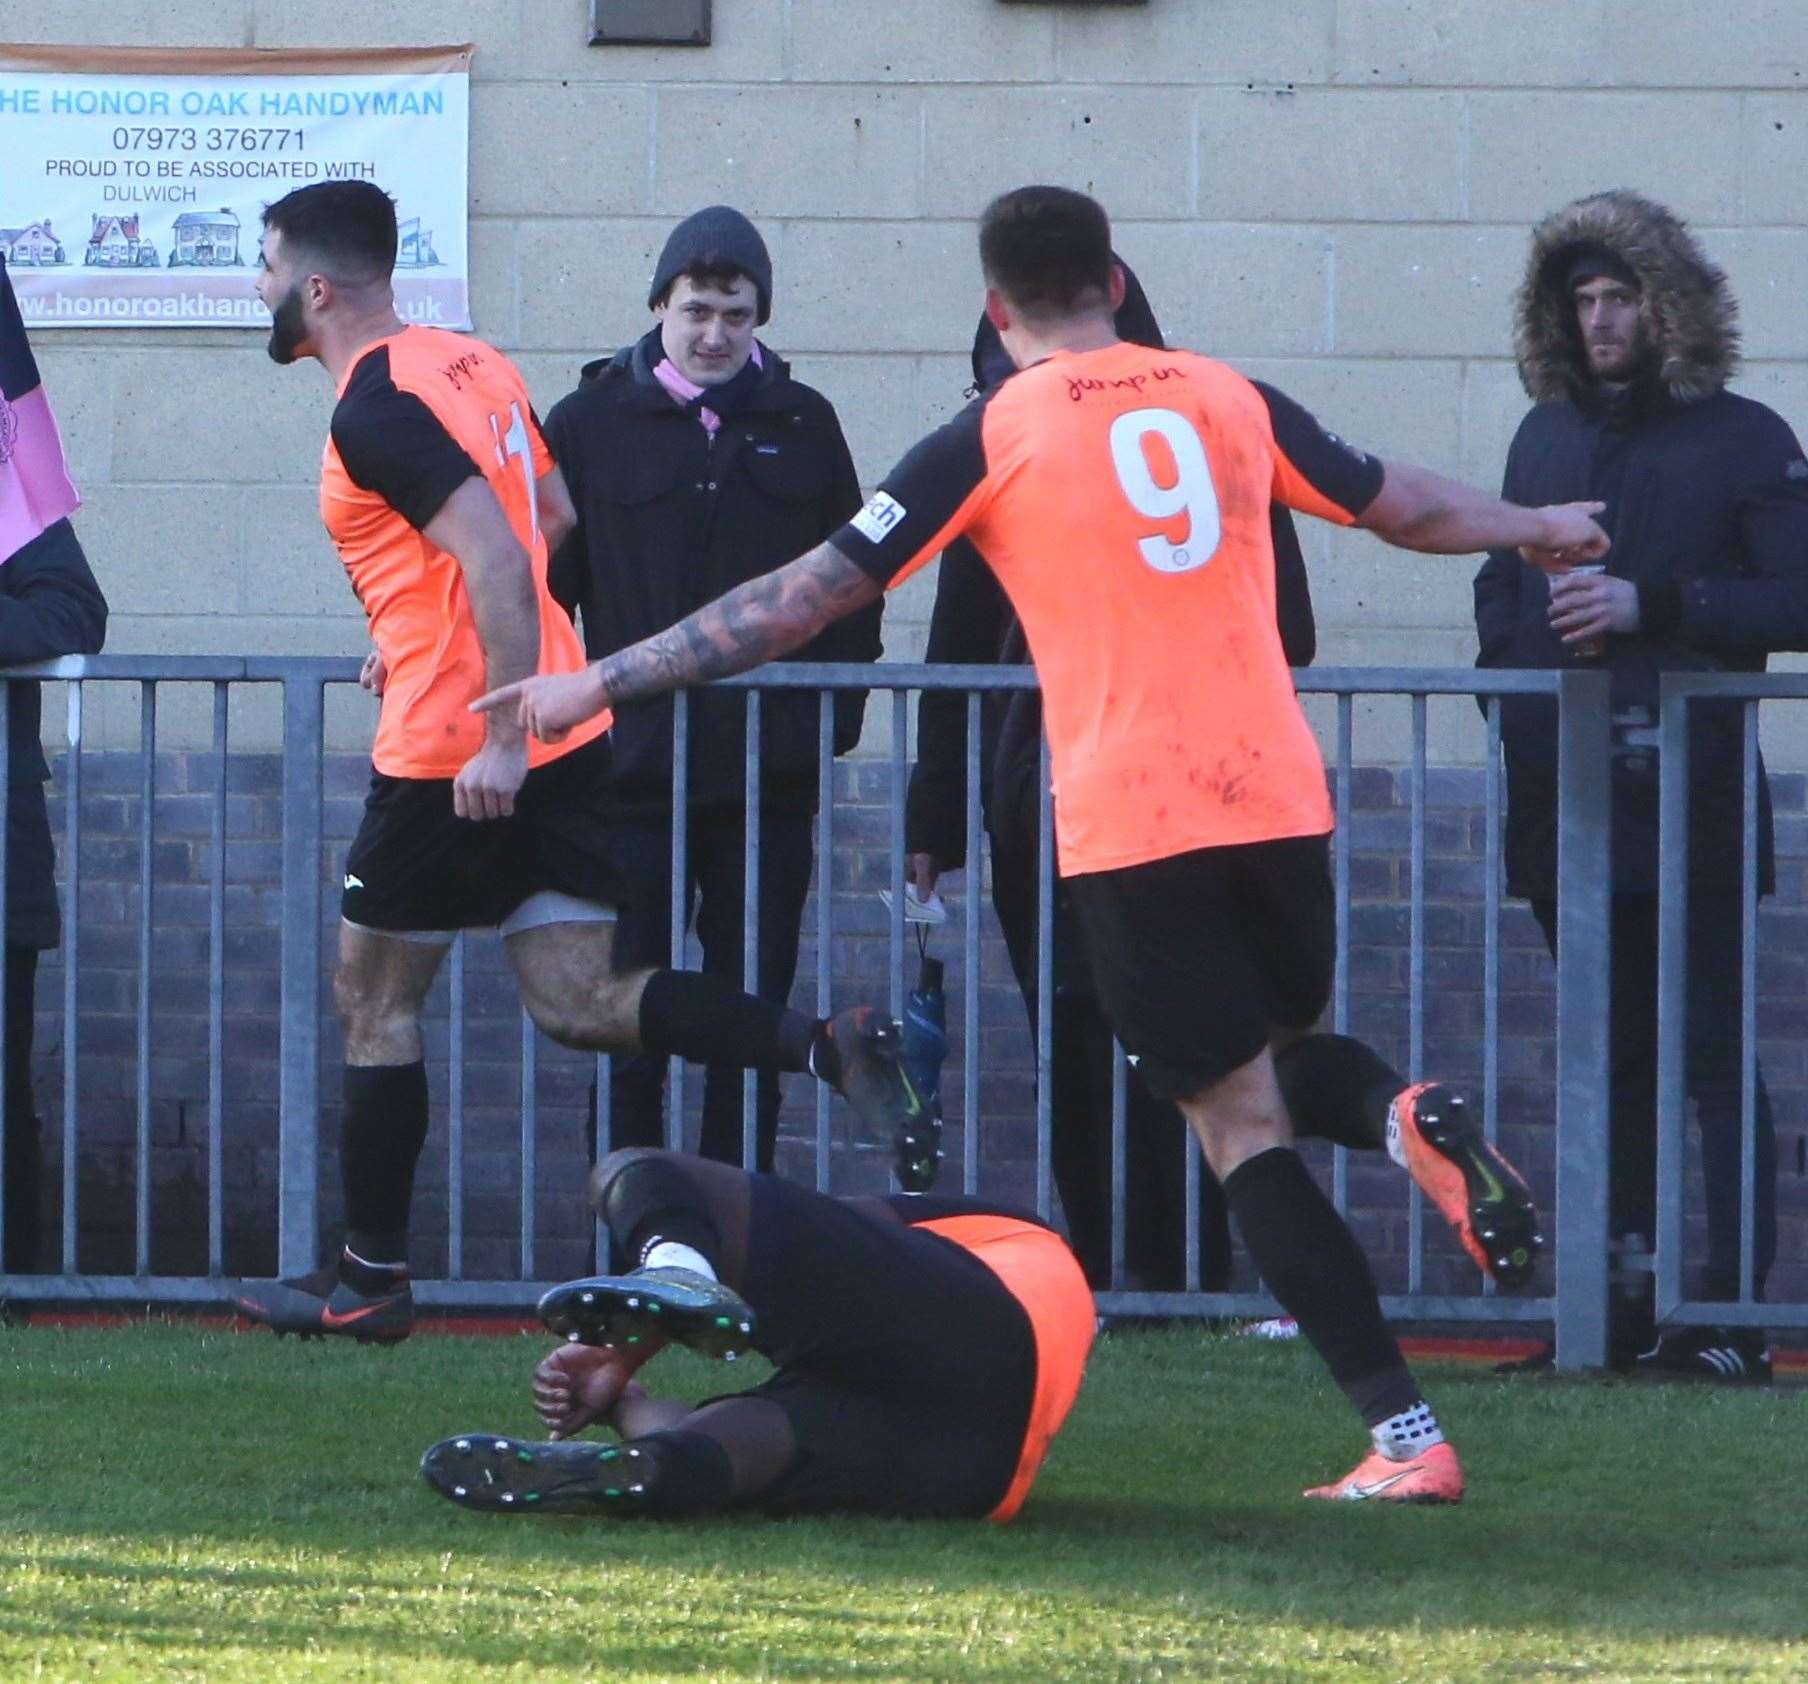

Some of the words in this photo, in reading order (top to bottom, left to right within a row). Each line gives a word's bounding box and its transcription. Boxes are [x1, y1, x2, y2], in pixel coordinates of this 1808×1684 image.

[52, 90, 169, 115] HONOR
[181, 91, 248, 116] OAK
[260, 91, 443, 116] HANDYMAN
[113, 127, 197, 150] 07973
[206, 128, 304, 151] 376771
[46, 160, 117, 177] PROUD
[124, 160, 150, 177] TO
[157, 161, 183, 177] BE
[189, 161, 318, 178] ASSOCIATED
[324, 161, 375, 178] WITH
[104, 185, 196, 201] DULWICH
[1109, 407, 1222, 573] 9
